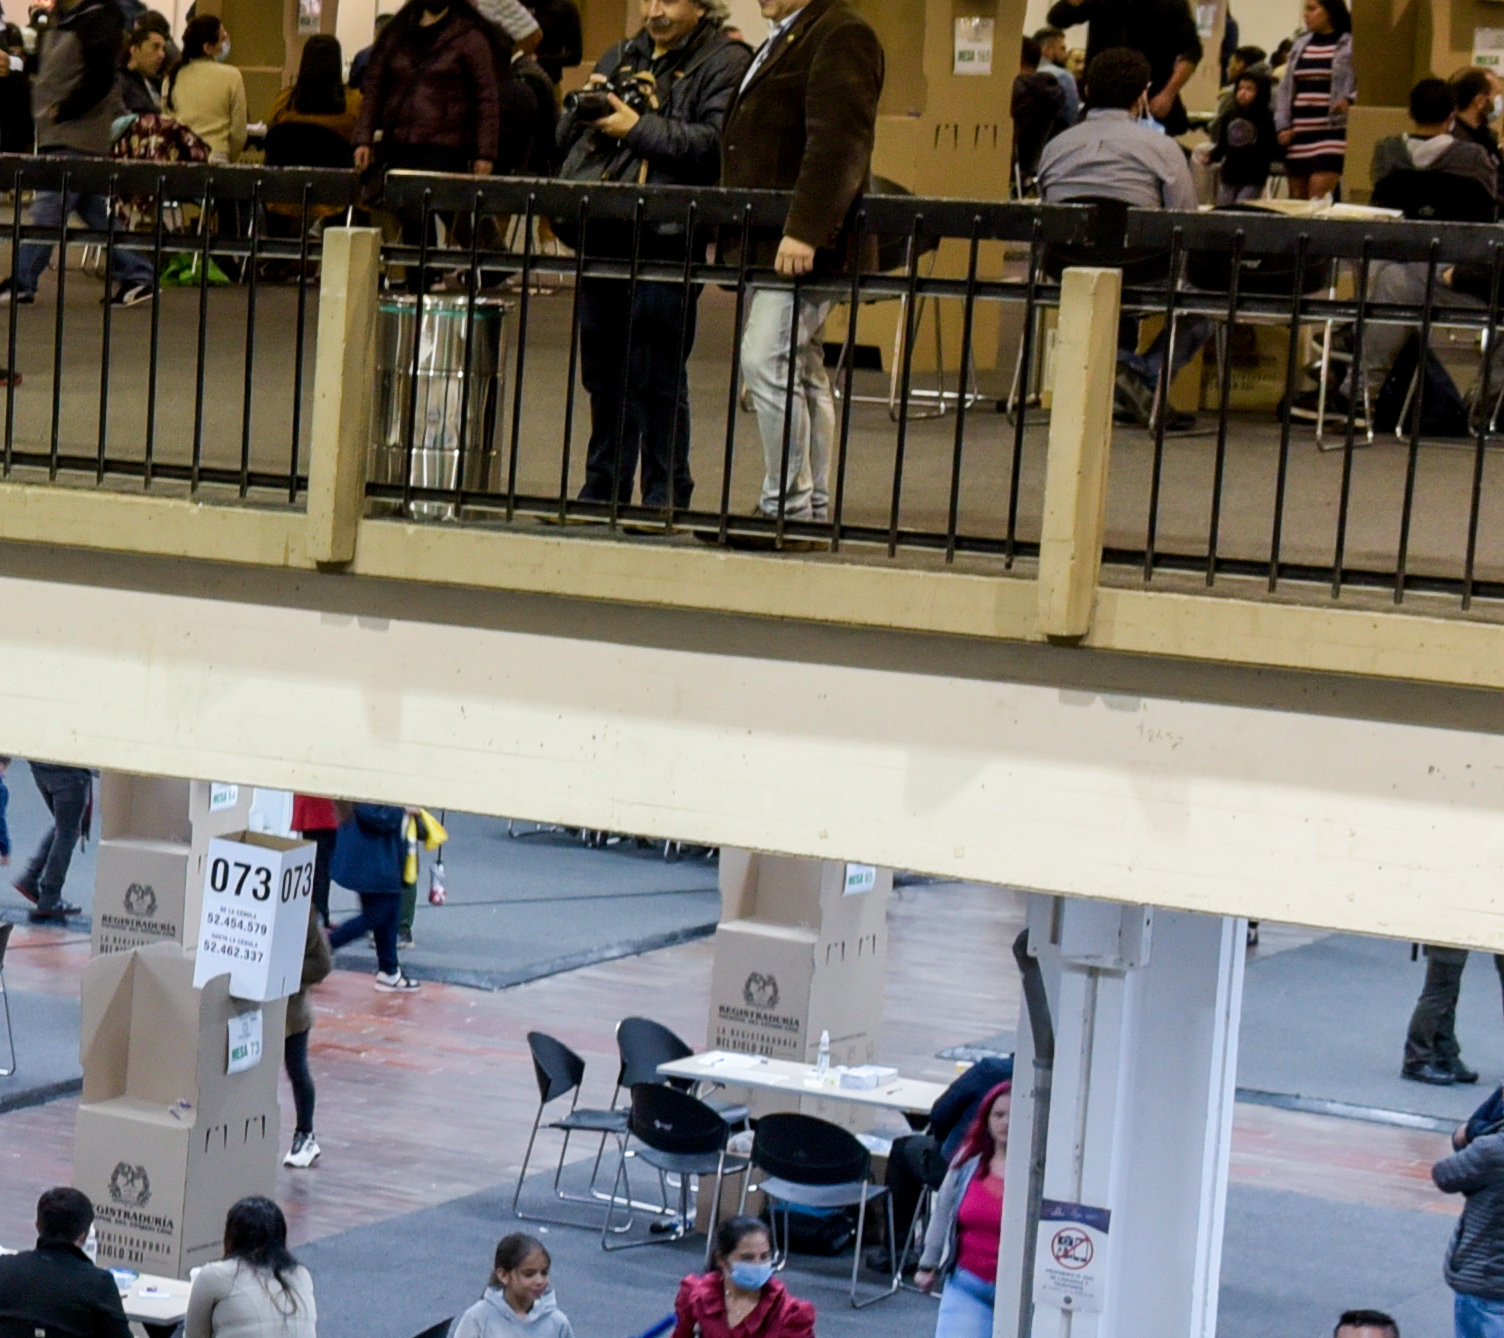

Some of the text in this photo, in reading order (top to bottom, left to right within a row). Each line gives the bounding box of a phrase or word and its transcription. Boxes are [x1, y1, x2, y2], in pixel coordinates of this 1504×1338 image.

[209, 857, 273, 902] 073
[281, 861, 314, 904] 073
[203, 941, 264, 964] 52.462.337
[91, 1204, 175, 1230] GISTRADURÍA
[128, 1248, 144, 1264] XXI
